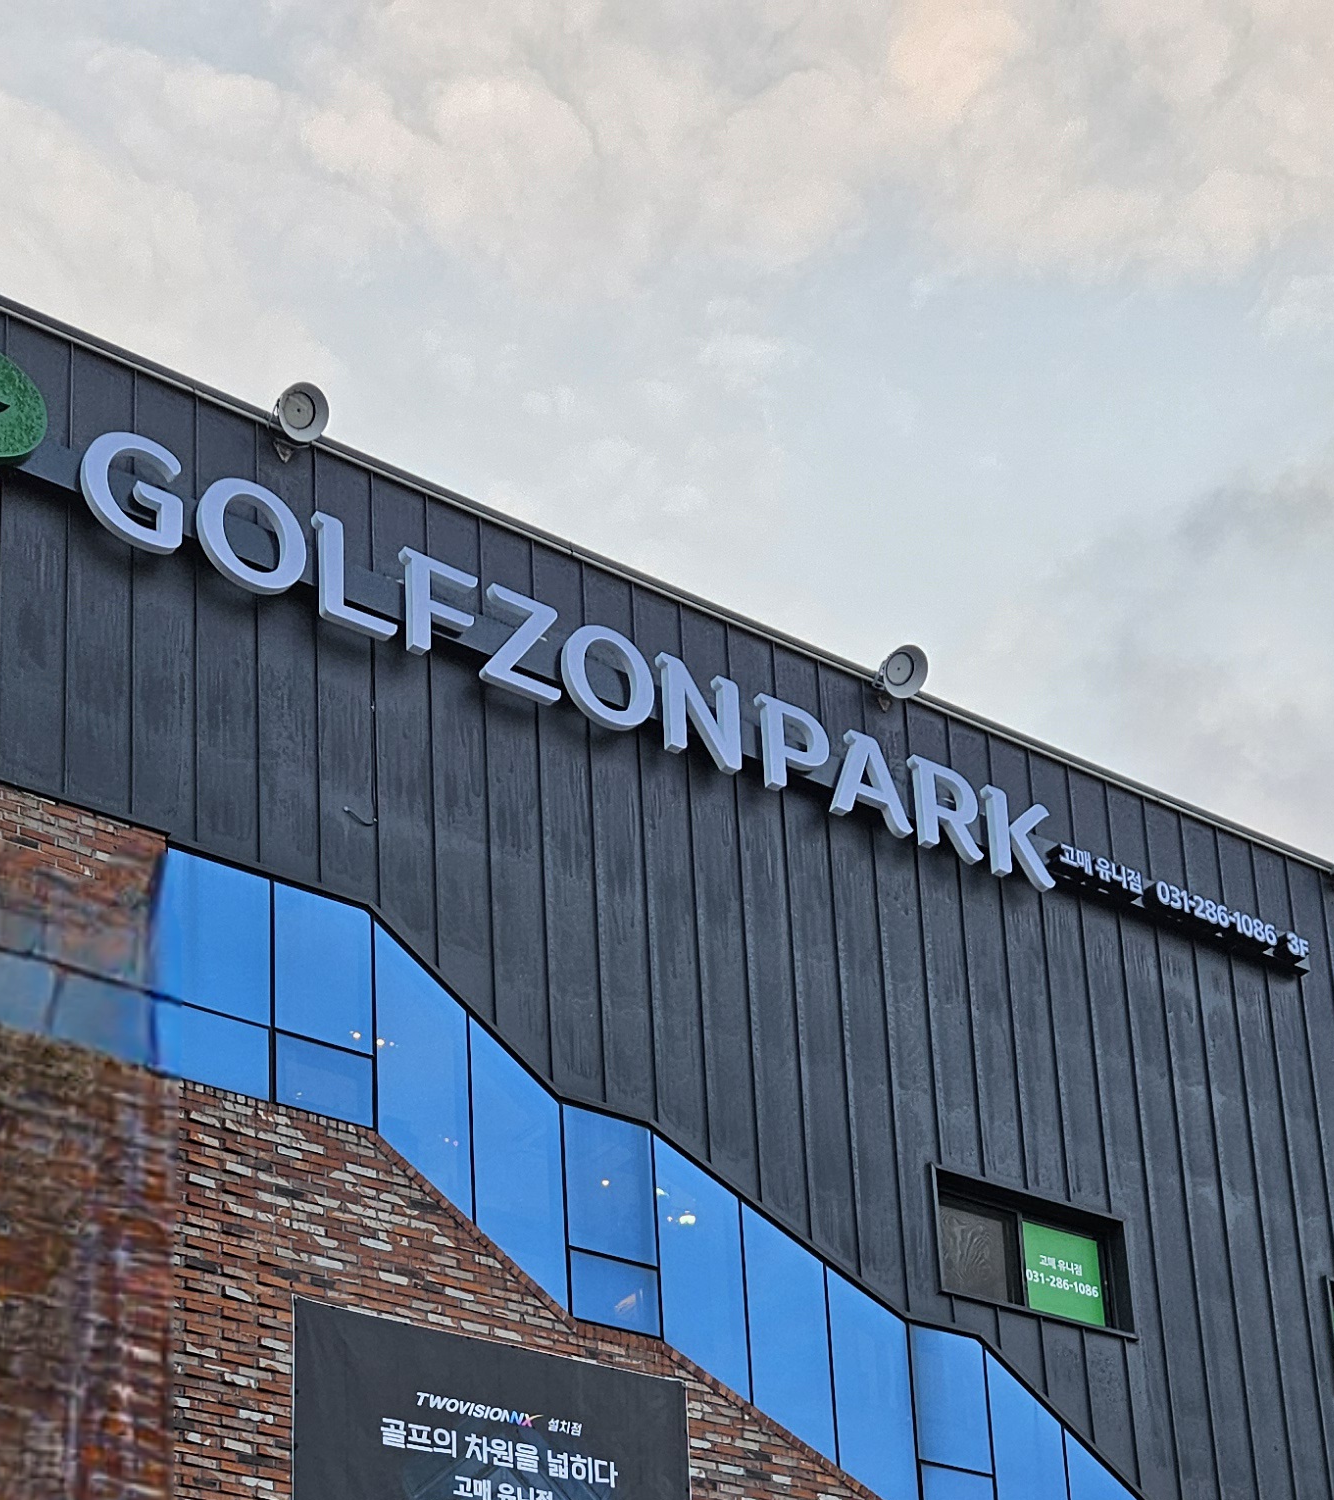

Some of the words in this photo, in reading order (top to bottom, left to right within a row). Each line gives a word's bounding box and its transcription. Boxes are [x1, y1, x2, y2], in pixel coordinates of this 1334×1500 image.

[1058, 843, 1094, 877] 고매
[1094, 856, 1144, 896] 유니점
[1155, 880, 1278, 946] 031-286-1086
[1286, 931, 1310, 958] 3F
[1025, 1268, 1099, 1298] 031-286-1086
[380, 1417, 458, 1459] 골프의
[464, 1432, 540, 1474] 차원을
[547, 1449, 619, 1489] 넓히다
[547, 1417, 584, 1438] 설치점
